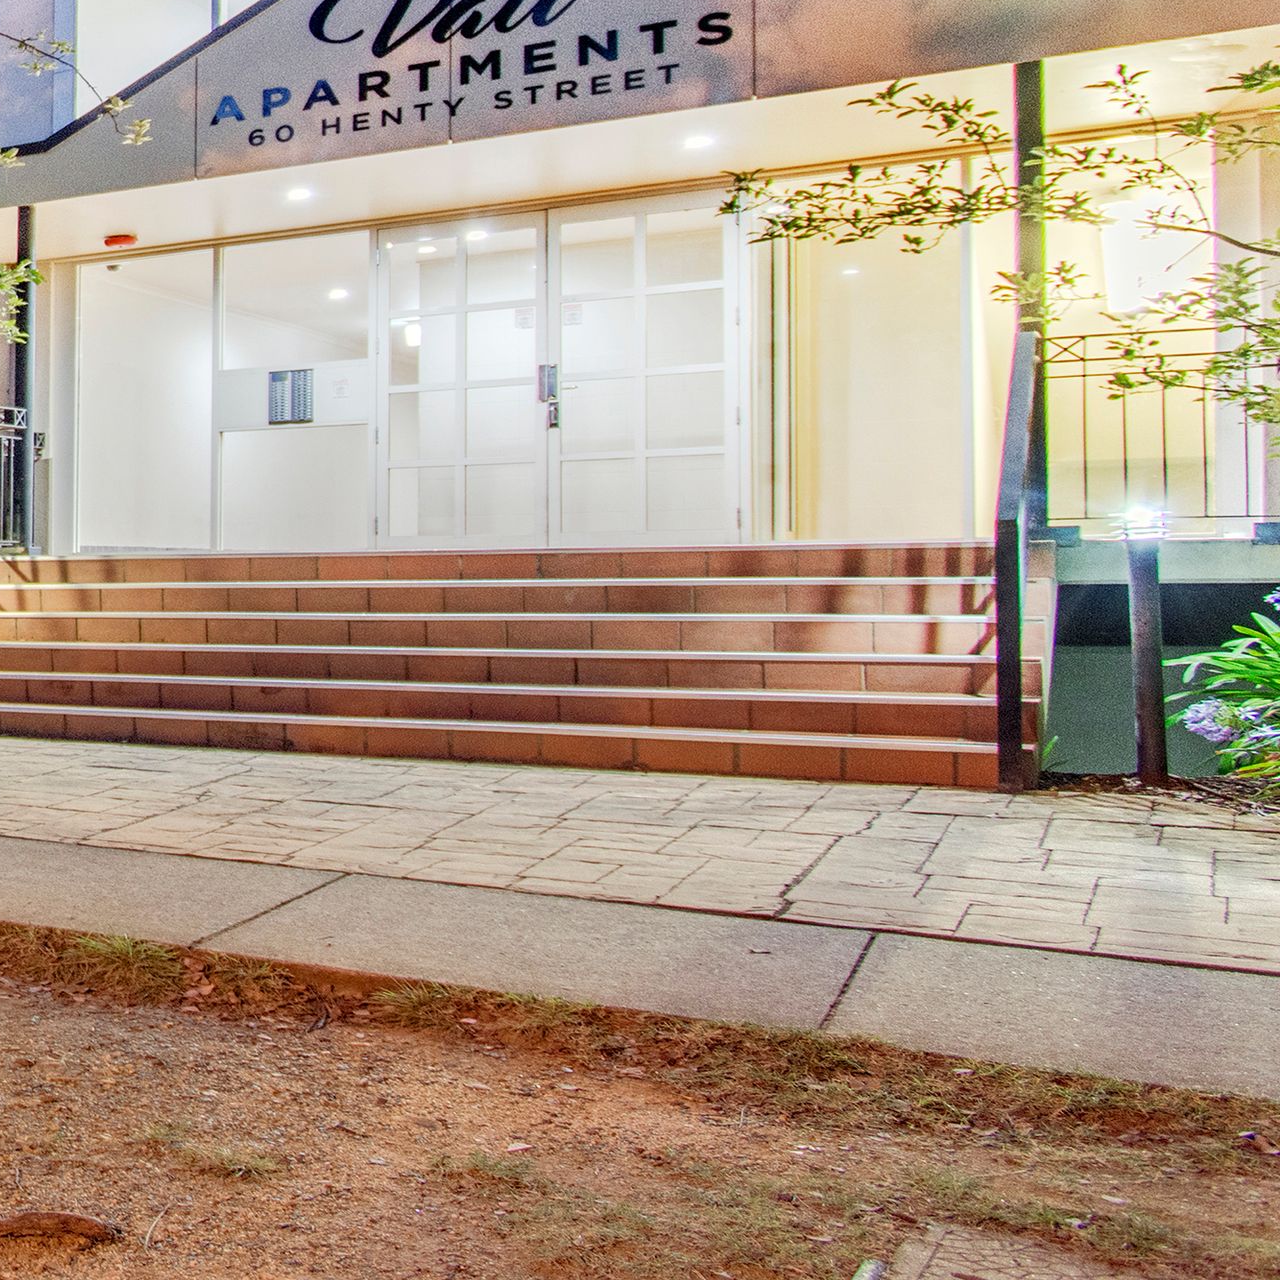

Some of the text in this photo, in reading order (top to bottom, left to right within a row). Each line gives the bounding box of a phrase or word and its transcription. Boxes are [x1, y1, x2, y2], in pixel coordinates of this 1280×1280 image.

[209, 11, 733, 126] APARTMENTS
[248, 62, 681, 147] 60 HENTY STREET
